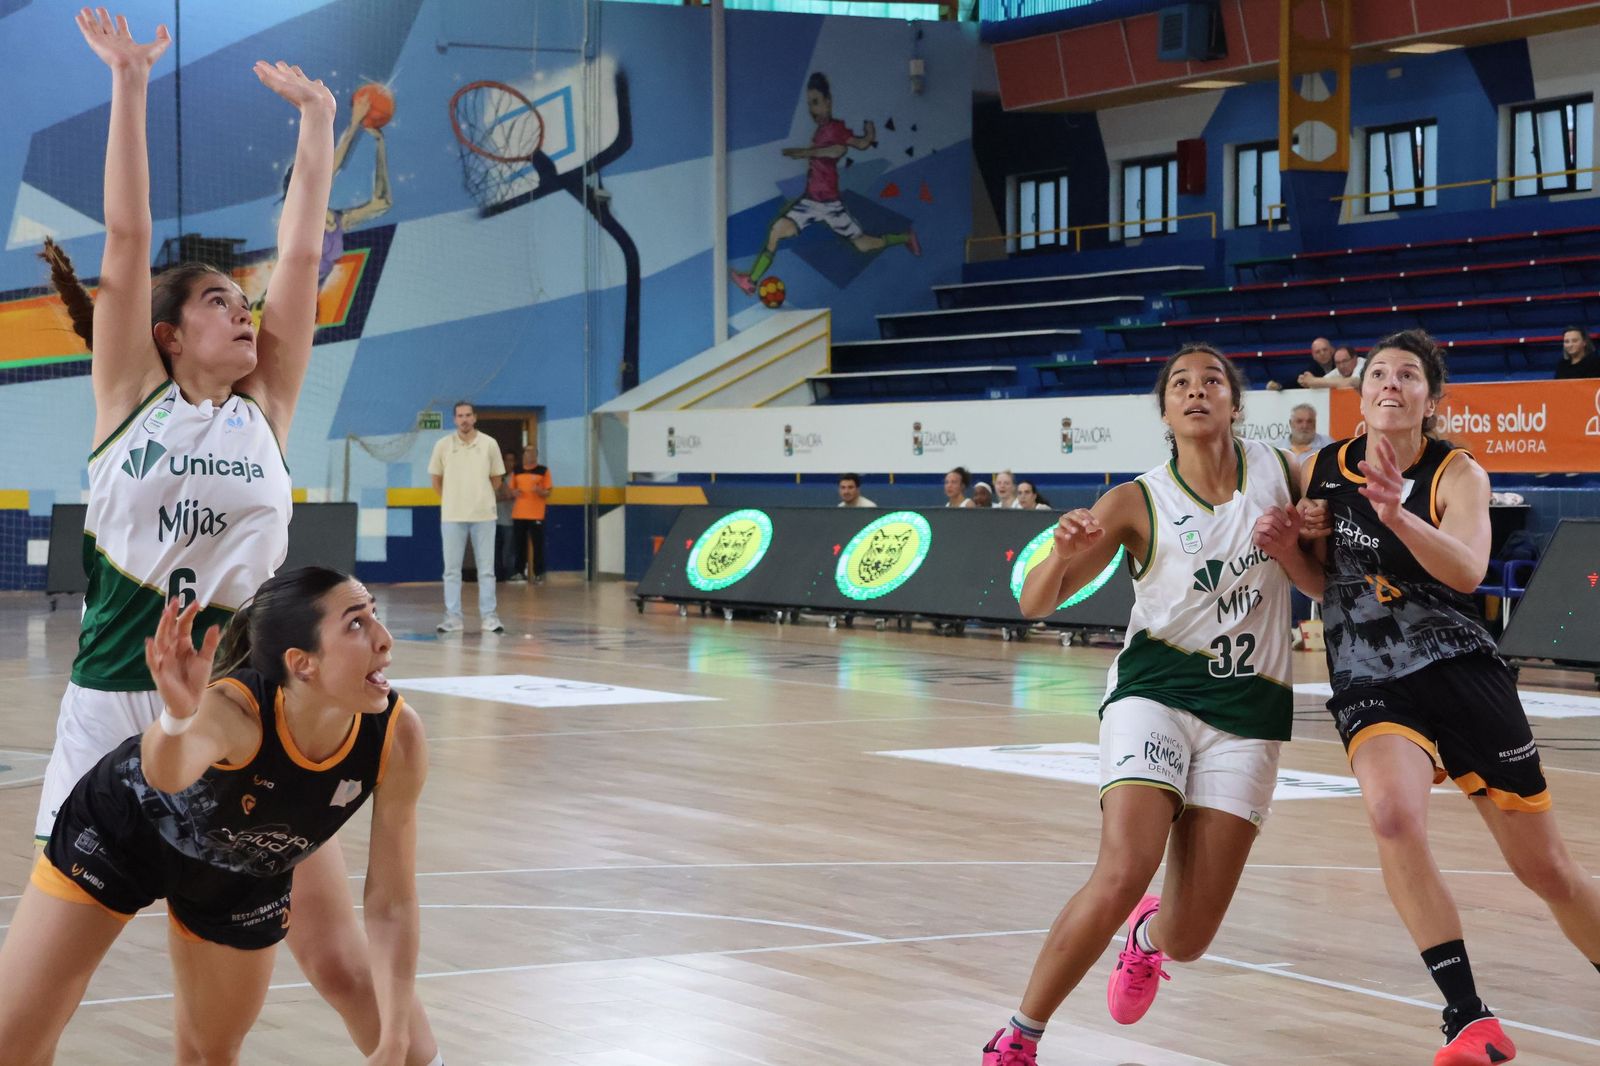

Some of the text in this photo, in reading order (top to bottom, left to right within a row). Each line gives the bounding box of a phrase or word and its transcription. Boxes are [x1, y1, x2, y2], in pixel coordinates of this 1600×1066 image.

[1496, 402, 1547, 433] salud
[1074, 426, 1112, 445] ZAMORA
[1248, 422, 1290, 440] ZAMORA
[1486, 439, 1547, 454] ZAMORA
[169, 453, 265, 483] Unicaja
[158, 499, 228, 548] Mijas
[1208, 632, 1256, 678] 32
[1431, 956, 1461, 972] WIBO
